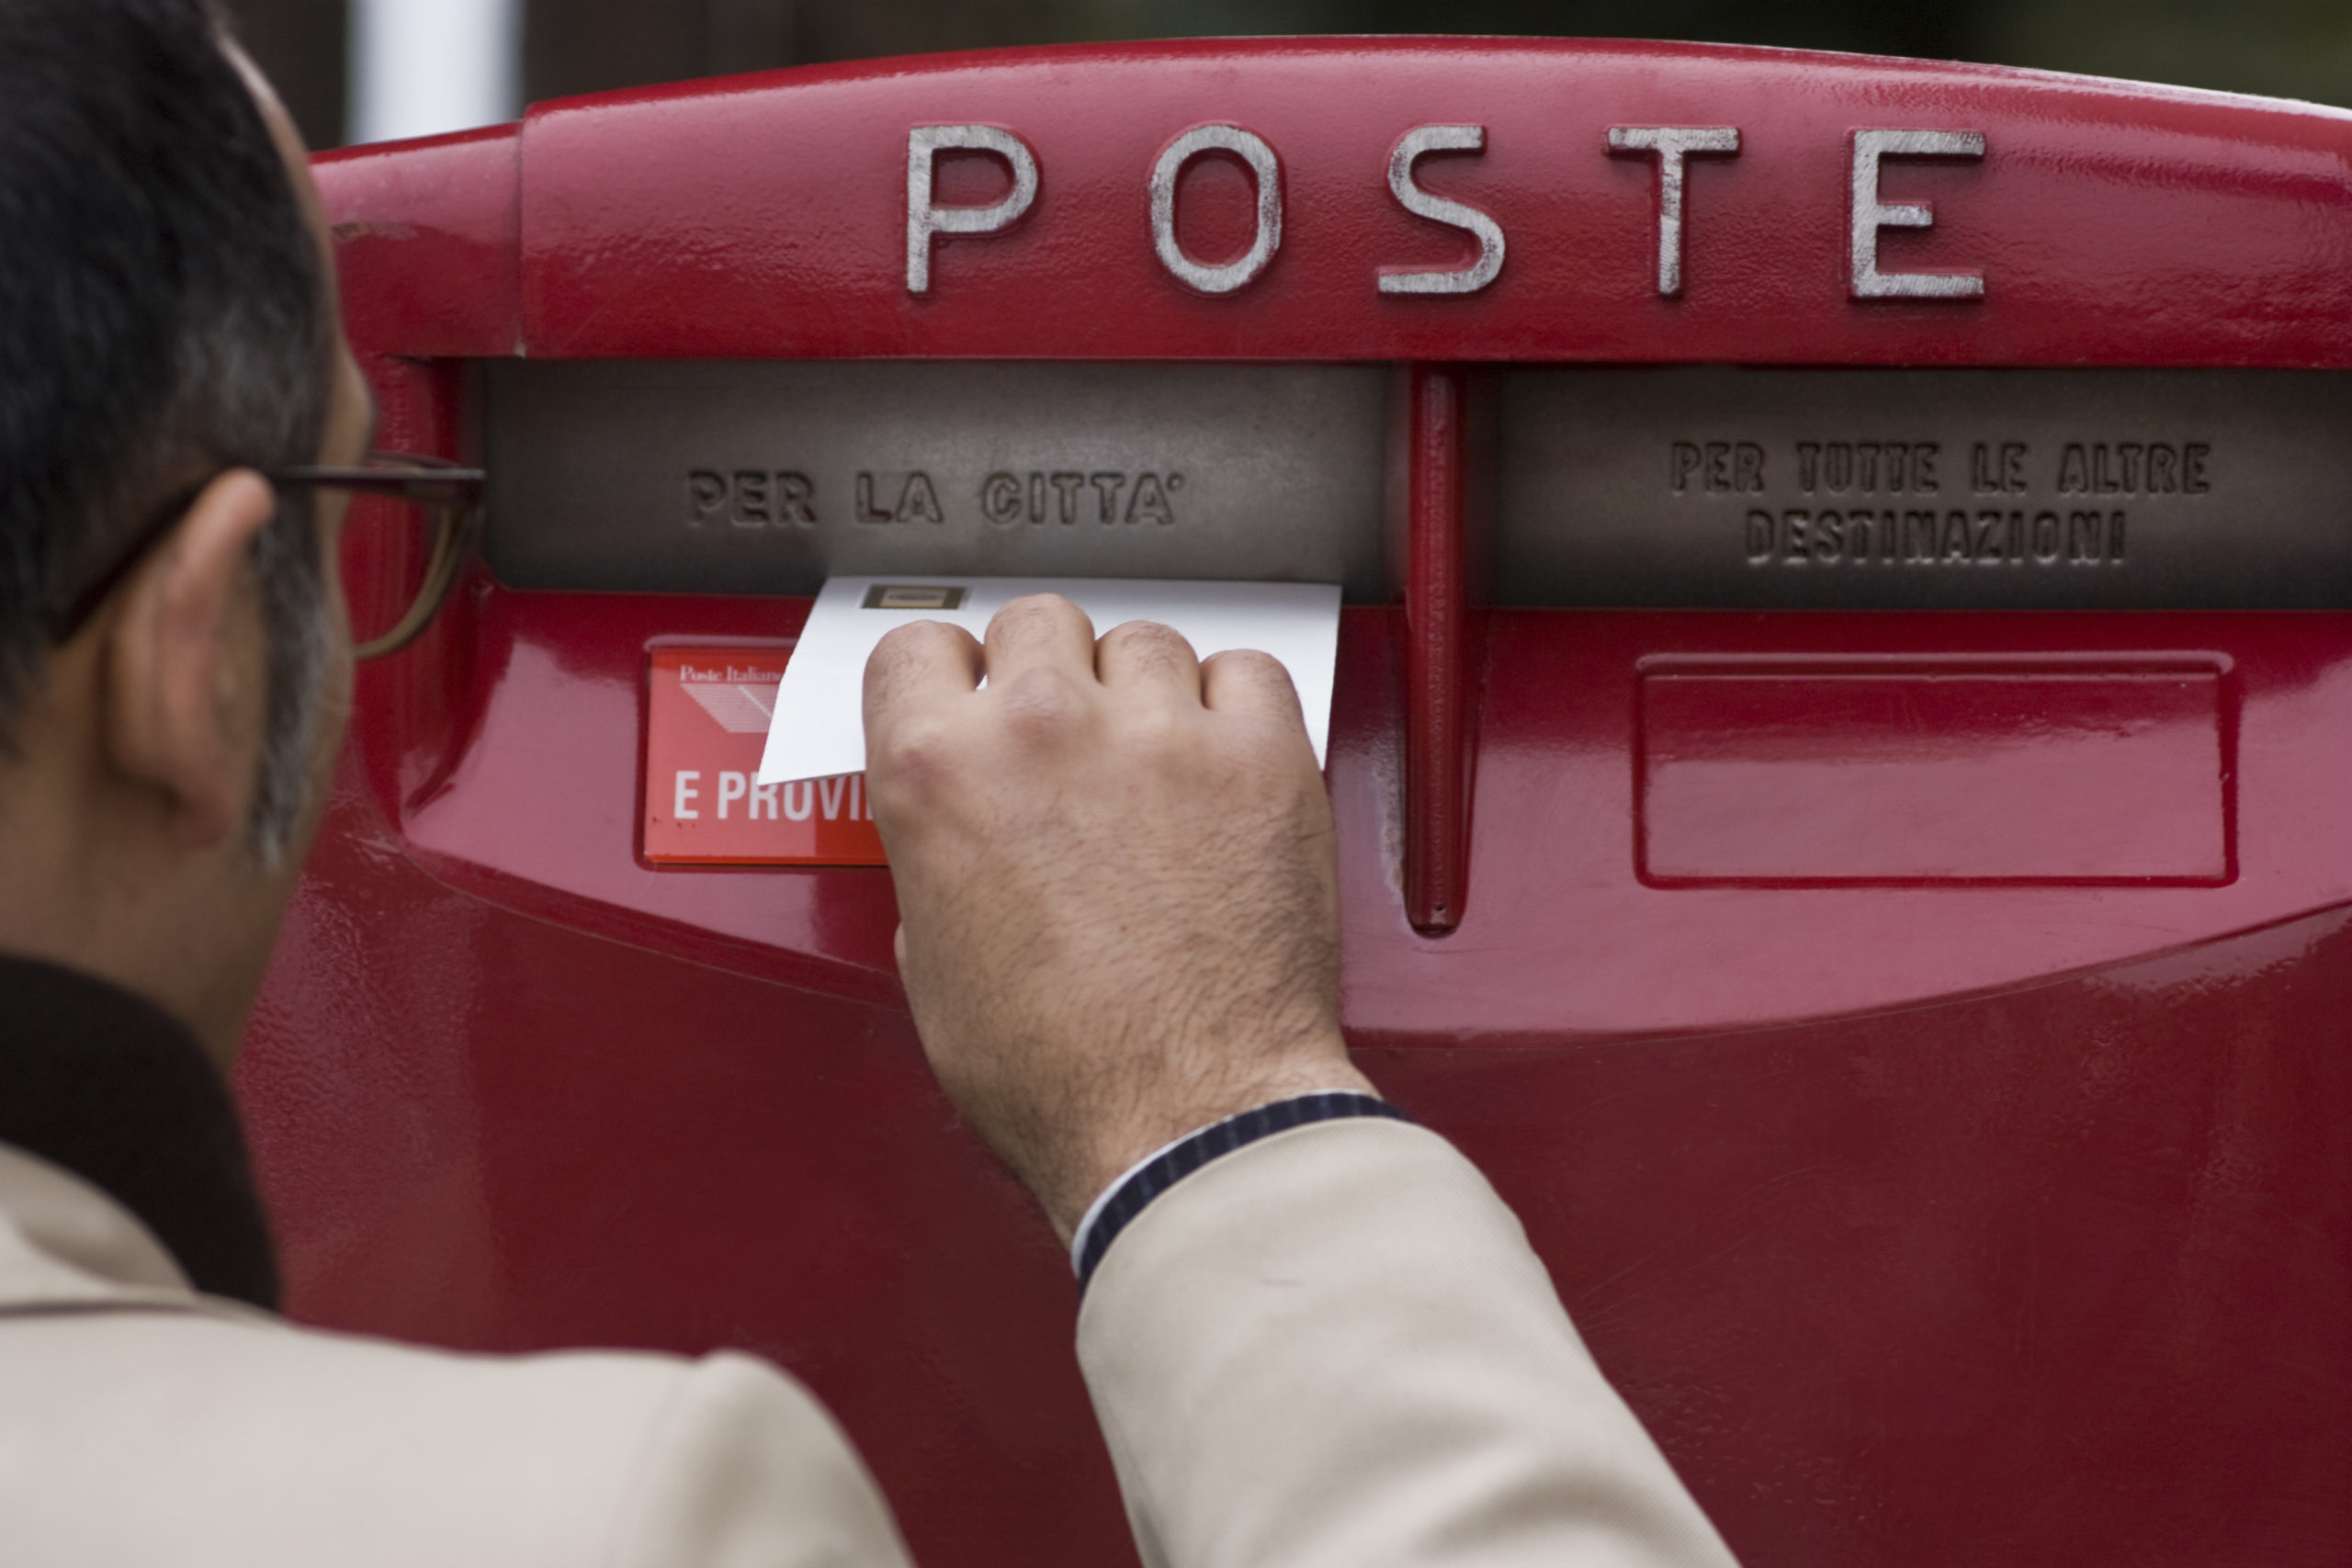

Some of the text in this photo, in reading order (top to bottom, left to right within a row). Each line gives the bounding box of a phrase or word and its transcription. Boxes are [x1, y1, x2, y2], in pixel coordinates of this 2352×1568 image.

[905, 121, 1986, 302] POSTE
[1669, 443, 2212, 493] PER TUTTE LE ALTRE
[688, 471, 816, 526] PER
[855, 471, 944, 524] LA
[1746, 510, 2126, 565] DESTINAZIONI
[680, 665, 723, 682] Poste
[673, 771, 874, 820] E PROVI
